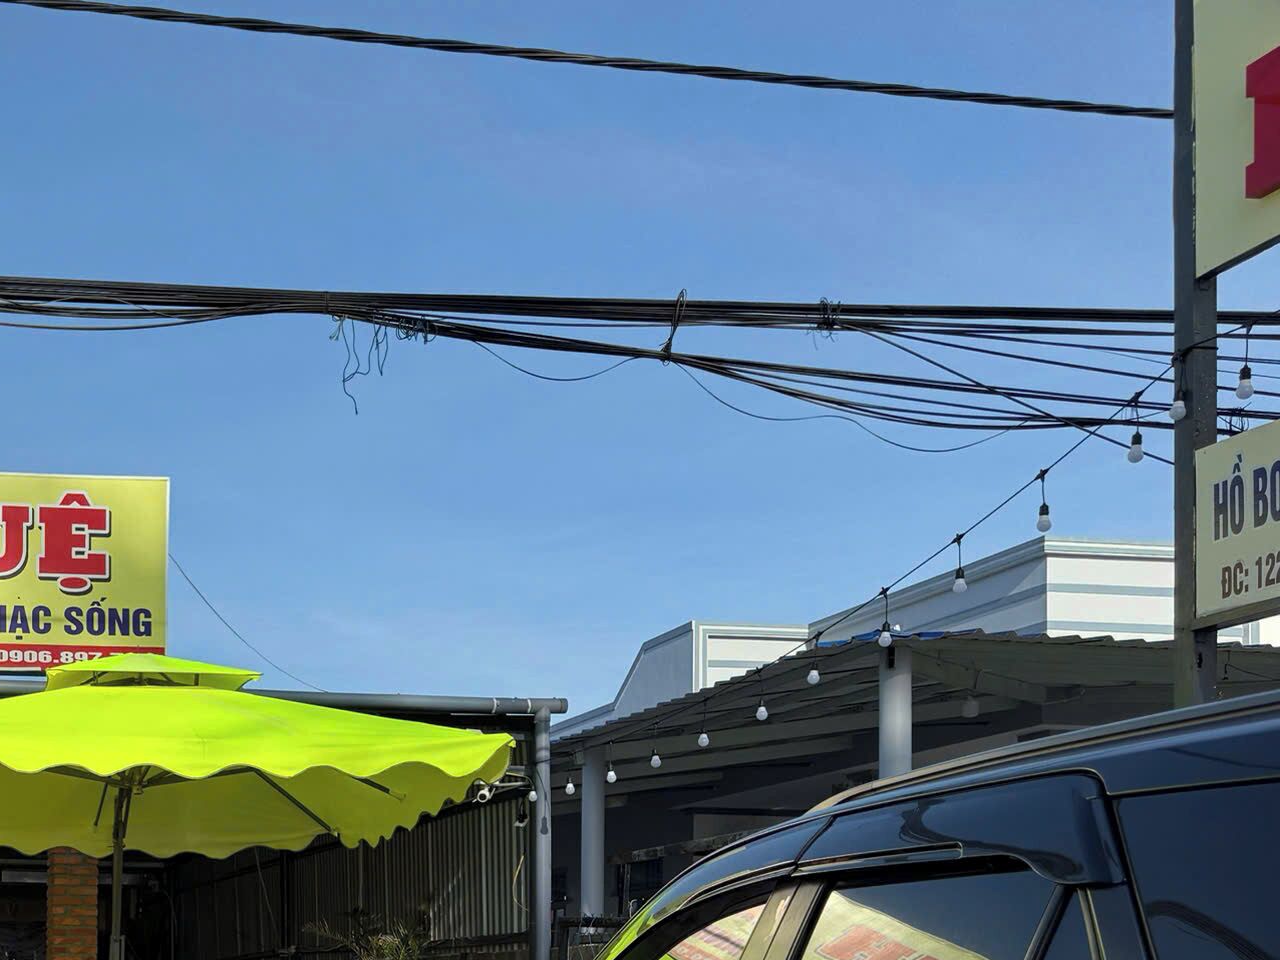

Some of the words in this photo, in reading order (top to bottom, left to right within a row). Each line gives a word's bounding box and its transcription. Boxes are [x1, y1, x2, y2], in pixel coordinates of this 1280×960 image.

[1213, 454, 1245, 541] HỒ
[1221, 561, 1249, 599] ĐC:
[64, 597, 152, 637] SỐNG
